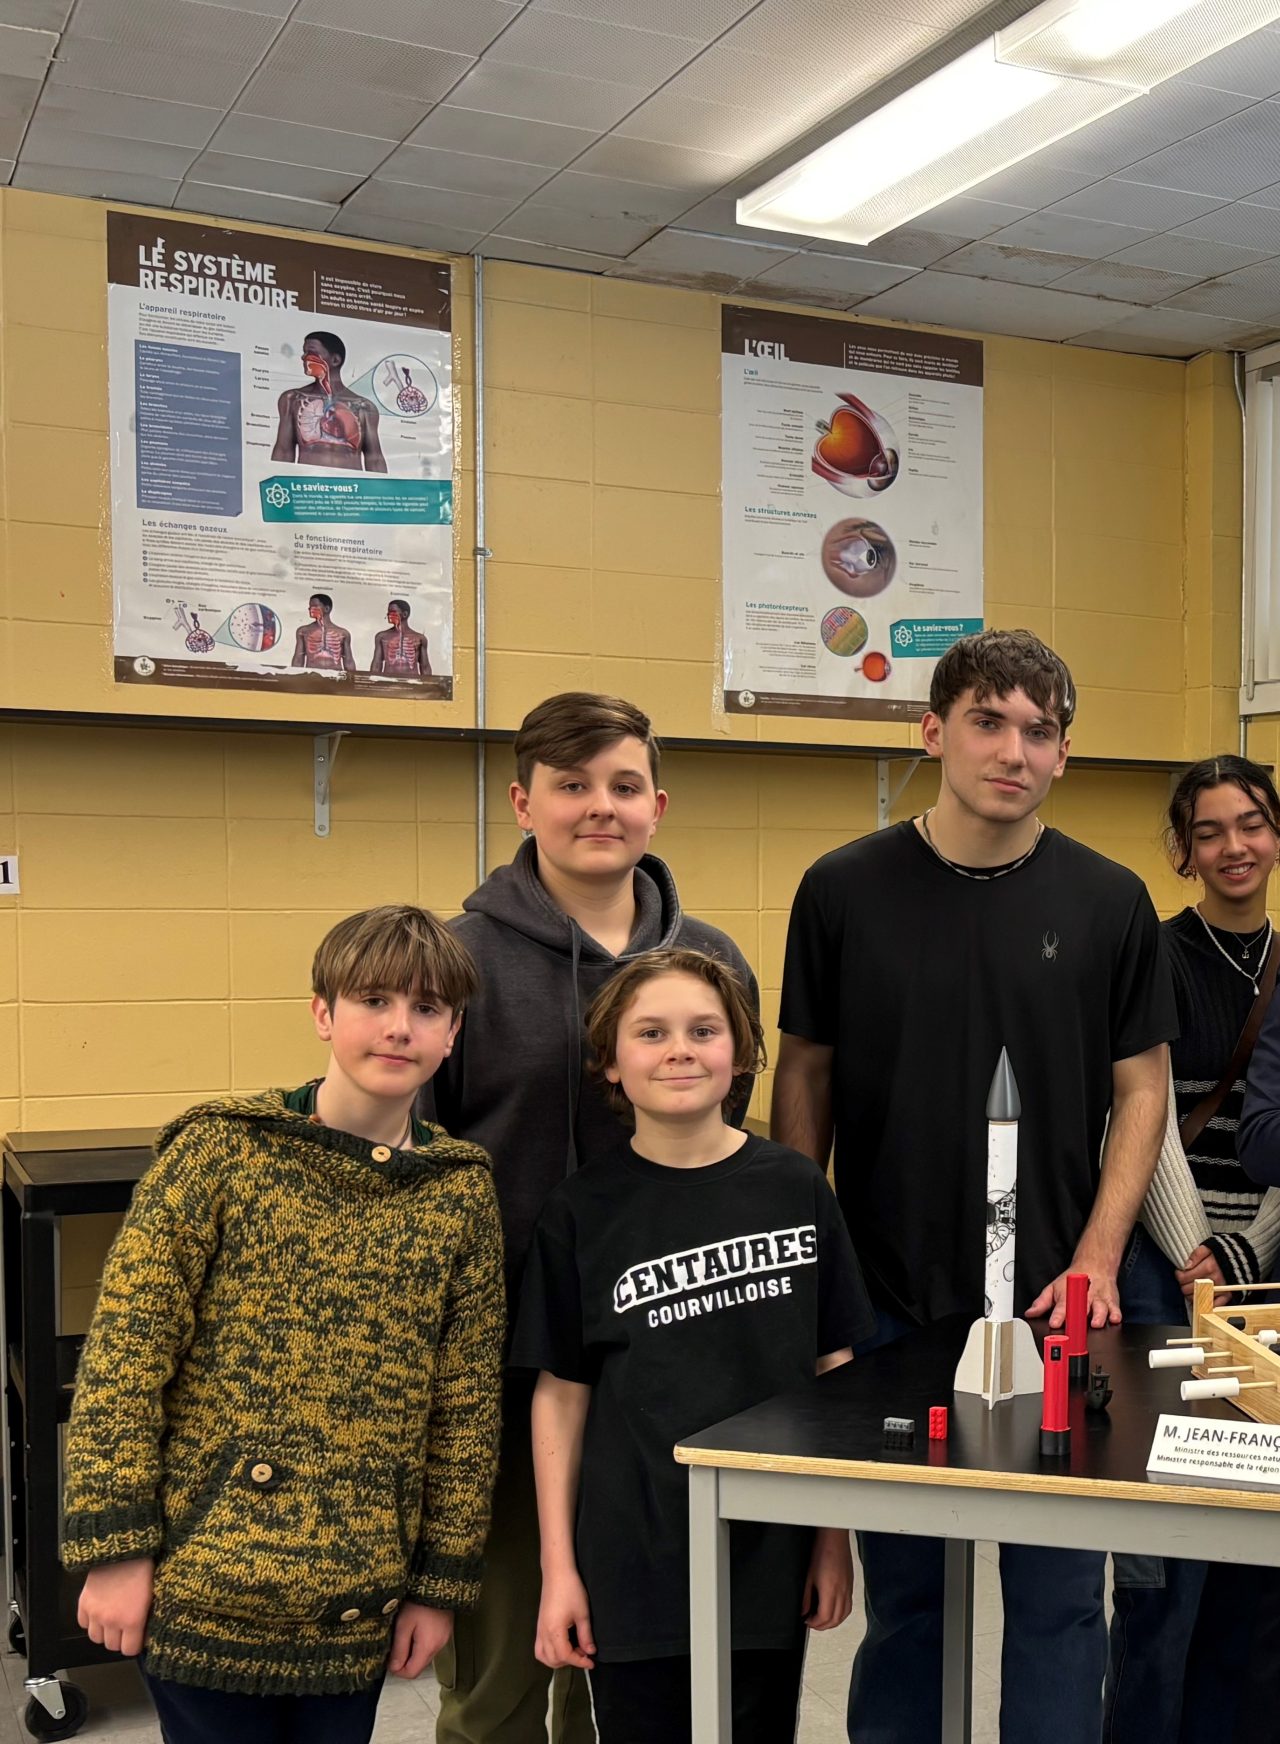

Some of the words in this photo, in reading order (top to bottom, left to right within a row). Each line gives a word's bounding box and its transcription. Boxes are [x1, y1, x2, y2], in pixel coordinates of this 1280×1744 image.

[174, 250, 277, 285] SYSTÈME
[139, 268, 299, 310] RESPIRATOIRE
[139, 302, 177, 315] L'appareil
[179, 309, 226, 321] respiratoire
[744, 338, 790, 360] L'ŒIL
[291, 482, 301, 491] Le
[142, 519, 157, 527] Les
[159, 520, 197, 531] échanges
[199, 525, 228, 533] gazeux
[294, 541, 304, 549] du
[306, 542, 338, 551] système
[340, 545, 383, 555] respiratoire
[306, 534, 365, 546] fonctionnement
[758, 602, 809, 612] photorécepteurs
[614, 1226, 817, 1312] CENTAURES
[648, 1276, 793, 1328] COURVILLOISE
[1163, 1424, 1181, 1439] M.
[1174, 1445, 1205, 1456] Ministre
[1206, 1448, 1220, 1457] des
[1221, 1451, 1261, 1461] ressources
[1156, 1454, 1187, 1464] Ministre
[1188, 1457, 1233, 1469] responsable
[1235, 1461, 1245, 1470] de
[1246, 1462, 1254, 1470] la
[1255, 1464, 1280, 1475] région
